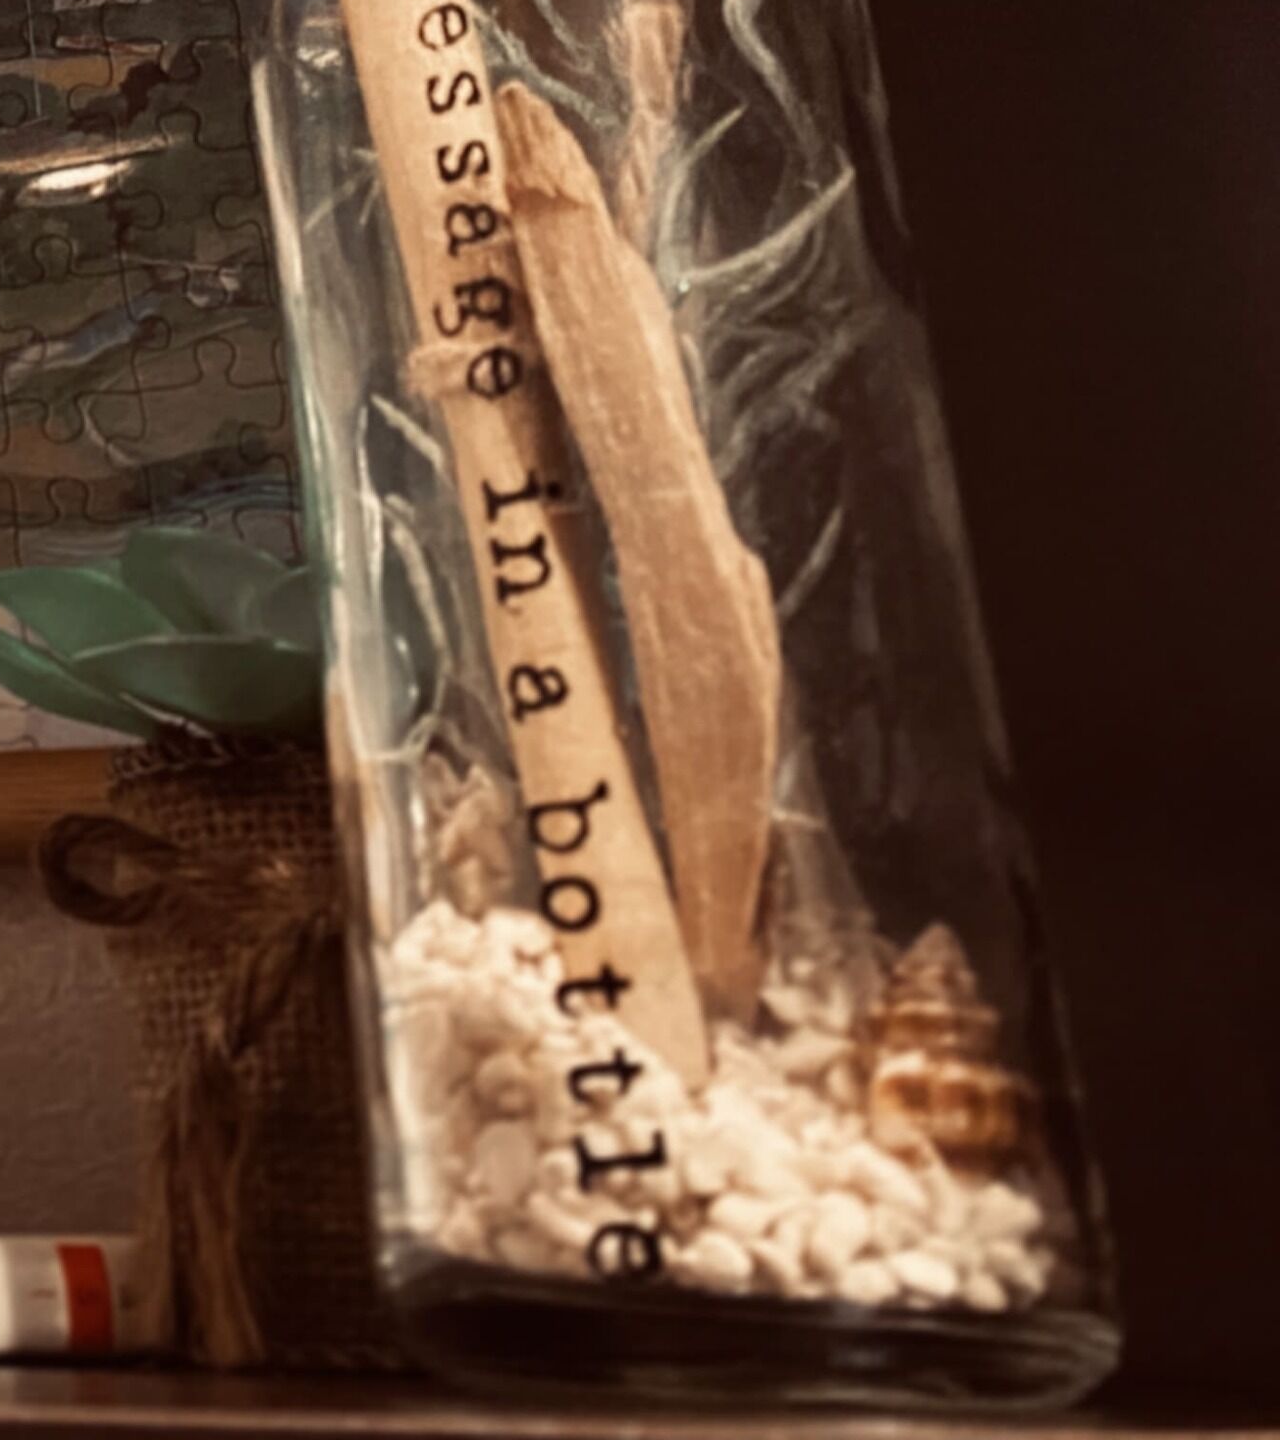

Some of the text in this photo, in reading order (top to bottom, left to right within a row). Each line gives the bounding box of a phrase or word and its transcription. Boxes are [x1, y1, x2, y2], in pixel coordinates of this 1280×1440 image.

[481, 466, 564, 608] in
[508, 663, 568, 722] a
[528, 780, 668, 1283] bottle
